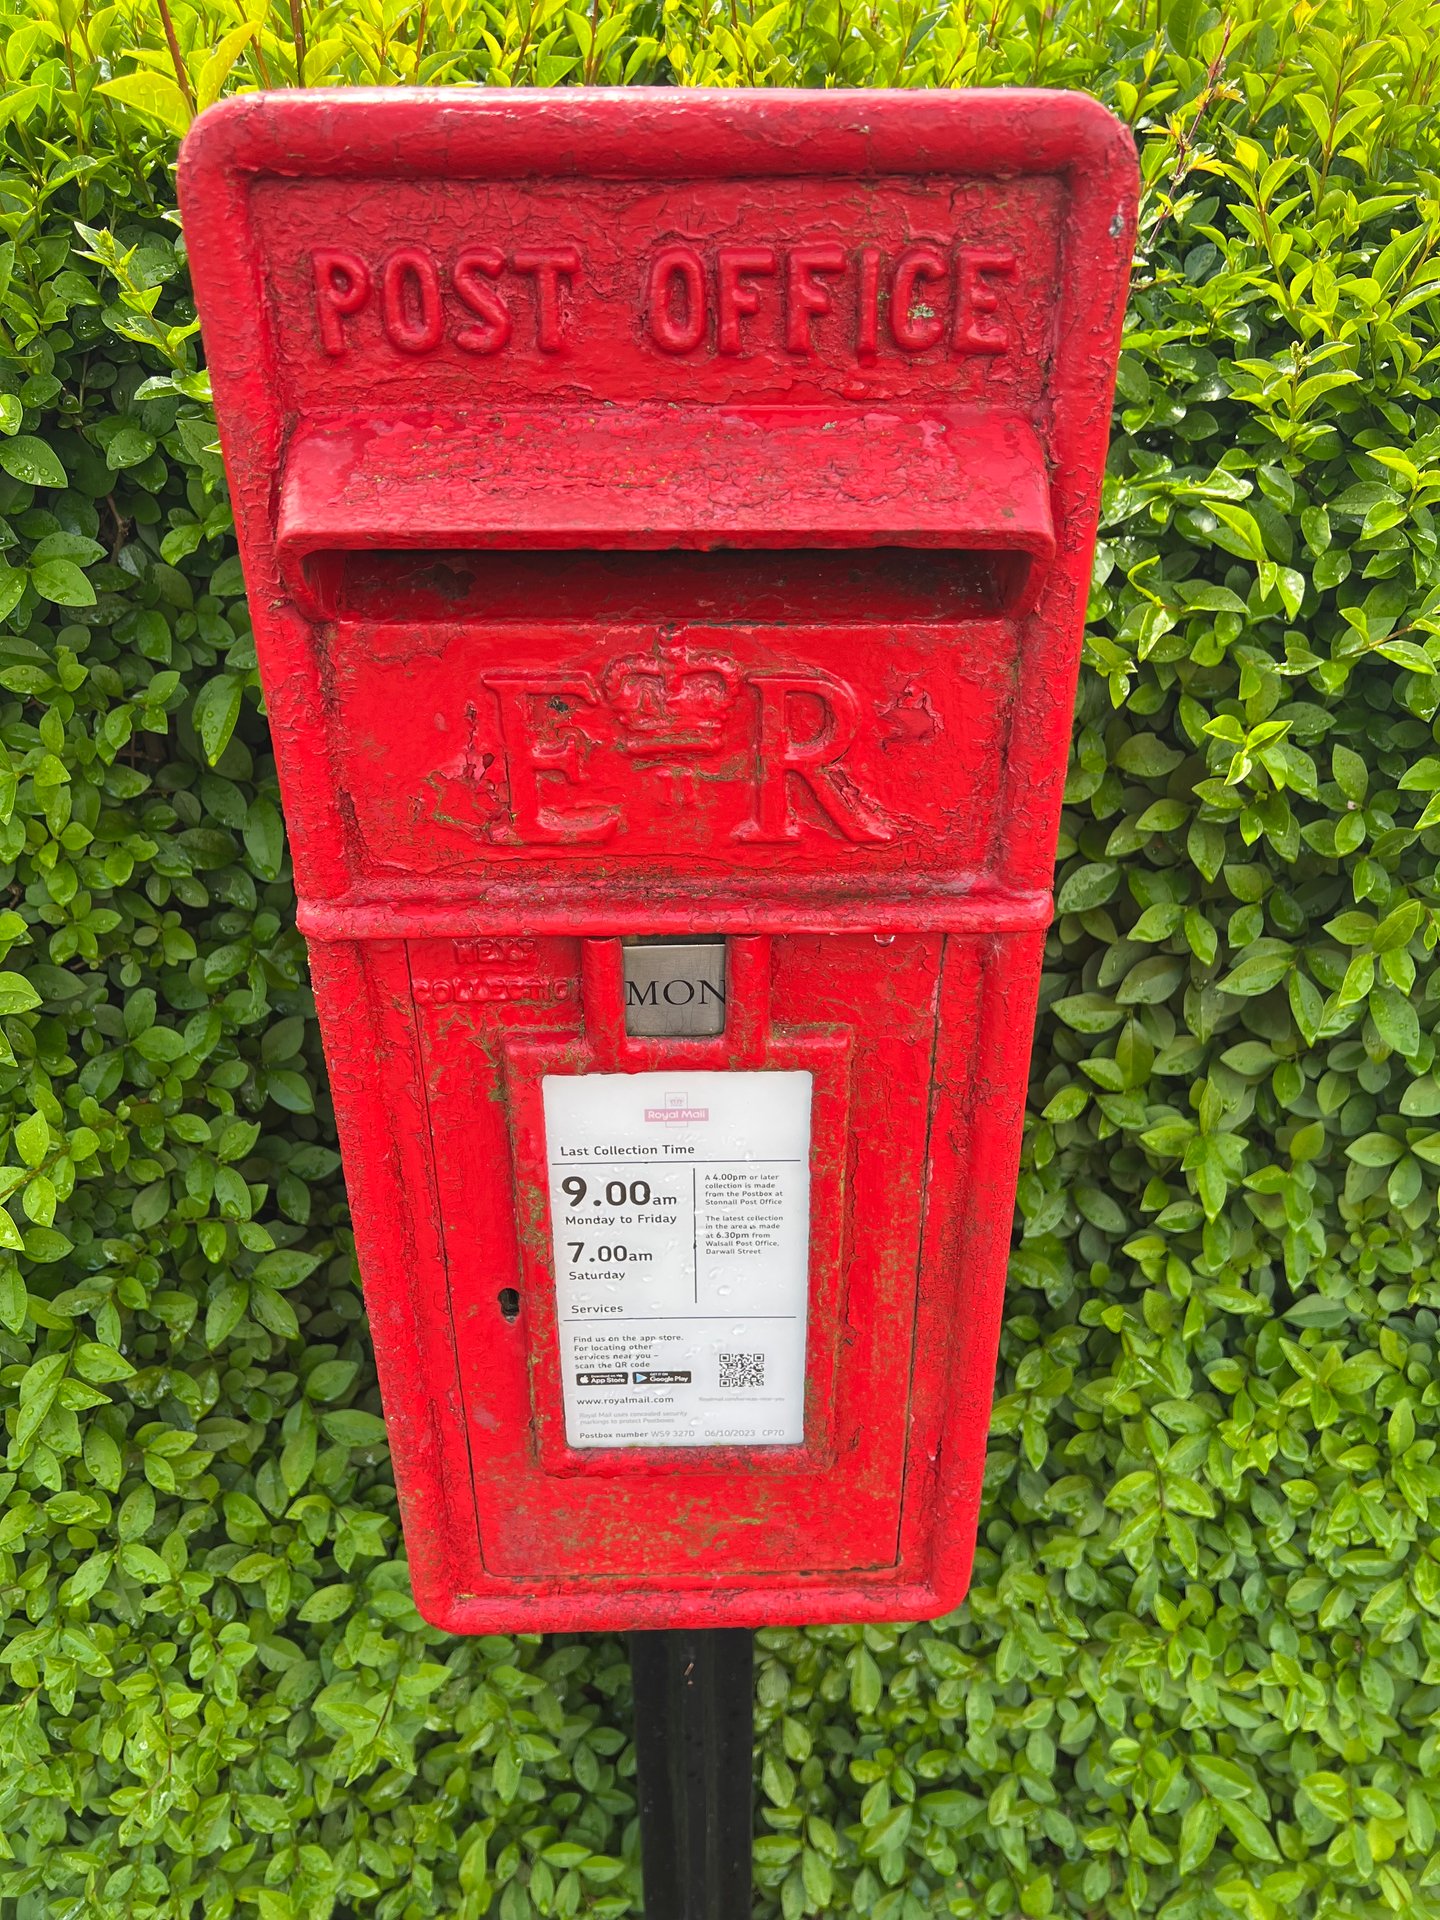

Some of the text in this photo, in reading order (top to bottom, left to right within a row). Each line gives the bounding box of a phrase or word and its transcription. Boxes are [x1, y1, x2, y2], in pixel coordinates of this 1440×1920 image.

[310, 244, 1018, 369] POST OFFICE
[625, 979, 726, 1006] MON
[648, 1109, 706, 1121] Royal Mail
[560, 1144, 695, 1156] Last Collection Time
[712, 1174, 747, 1182] 4.00pm
[561, 1176, 678, 1207] 9.00am
[705, 1182, 742, 1190] collection
[565, 1214, 678, 1226] Monday to Friday
[716, 1232, 750, 1240] 6.30pm
[566, 1241, 653, 1263] 7.00am
[568, 1270, 626, 1281] Saturday
[571, 1304, 624, 1314] Services
[574, 1344, 589, 1352] For
[591, 1344, 626, 1352] locating
[576, 1396, 674, 1406] www.royalmail.com
